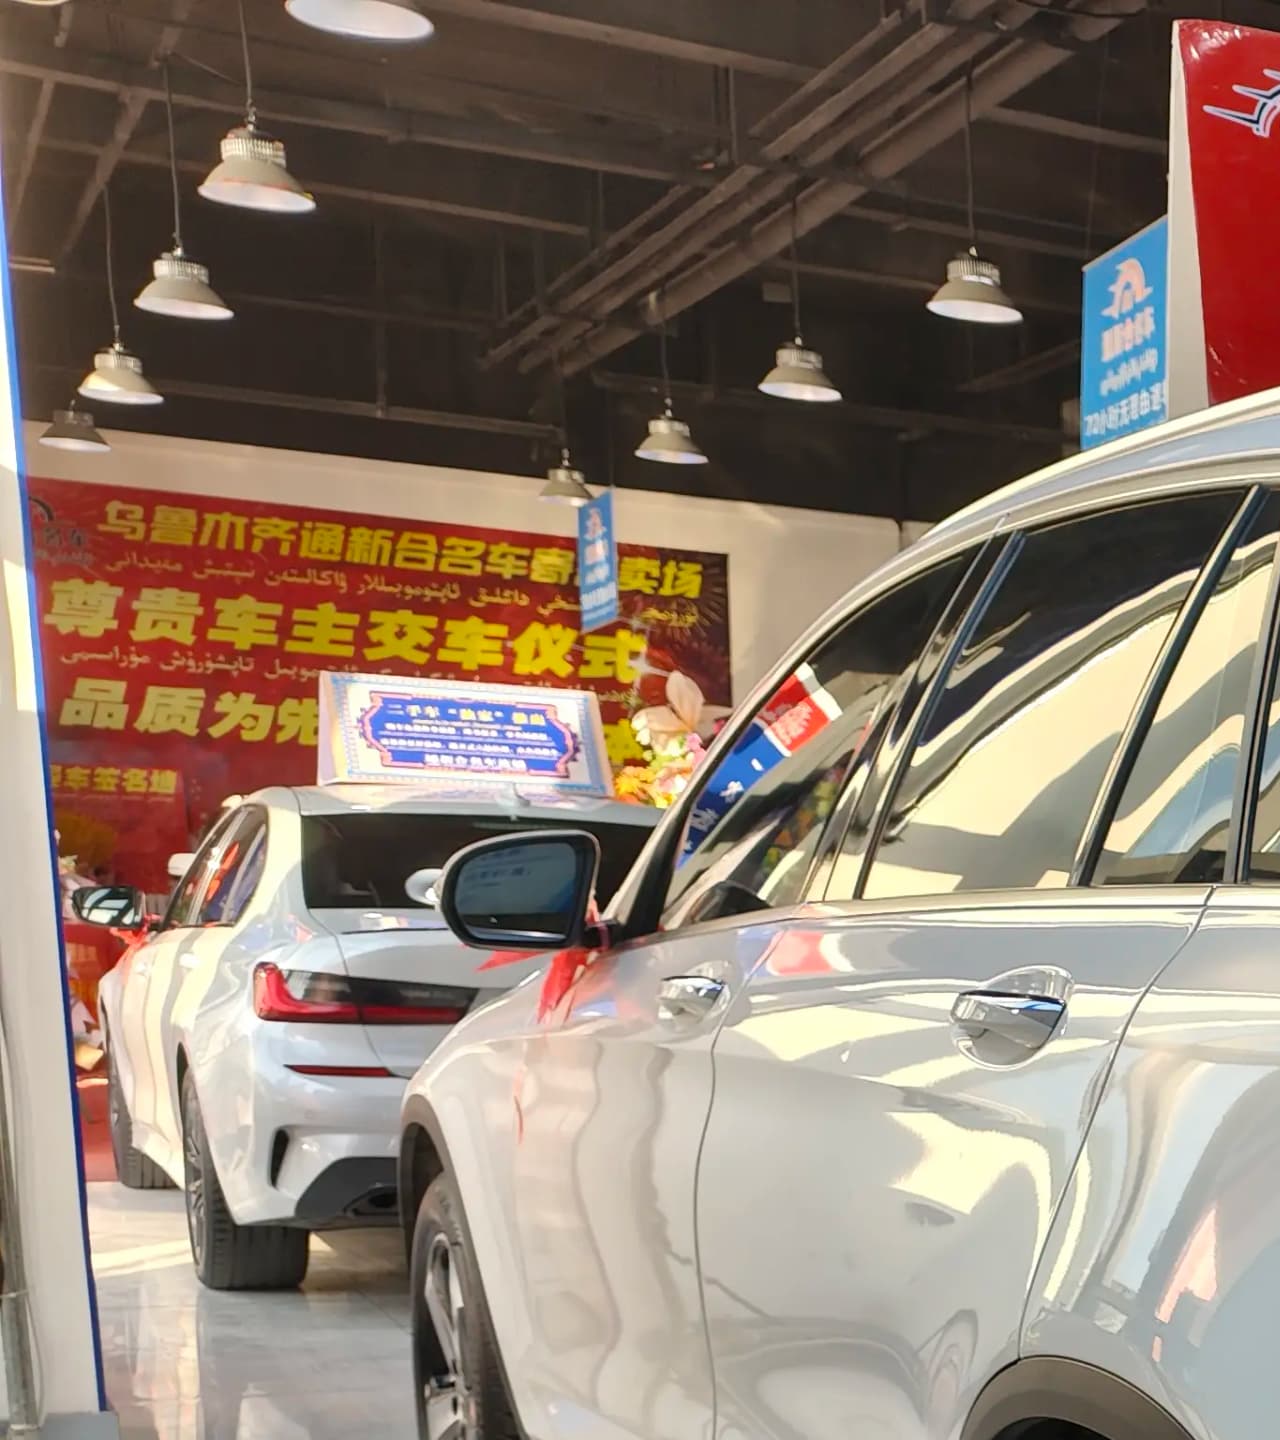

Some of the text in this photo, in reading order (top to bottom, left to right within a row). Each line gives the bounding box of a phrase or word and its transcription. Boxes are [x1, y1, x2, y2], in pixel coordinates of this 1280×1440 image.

[97, 500, 704, 599] 乌鲁木齐通新合名车寄卖场
[43, 577, 648, 684] 尊贵车主交车仪式
[59, 677, 320, 746] 品质为先
